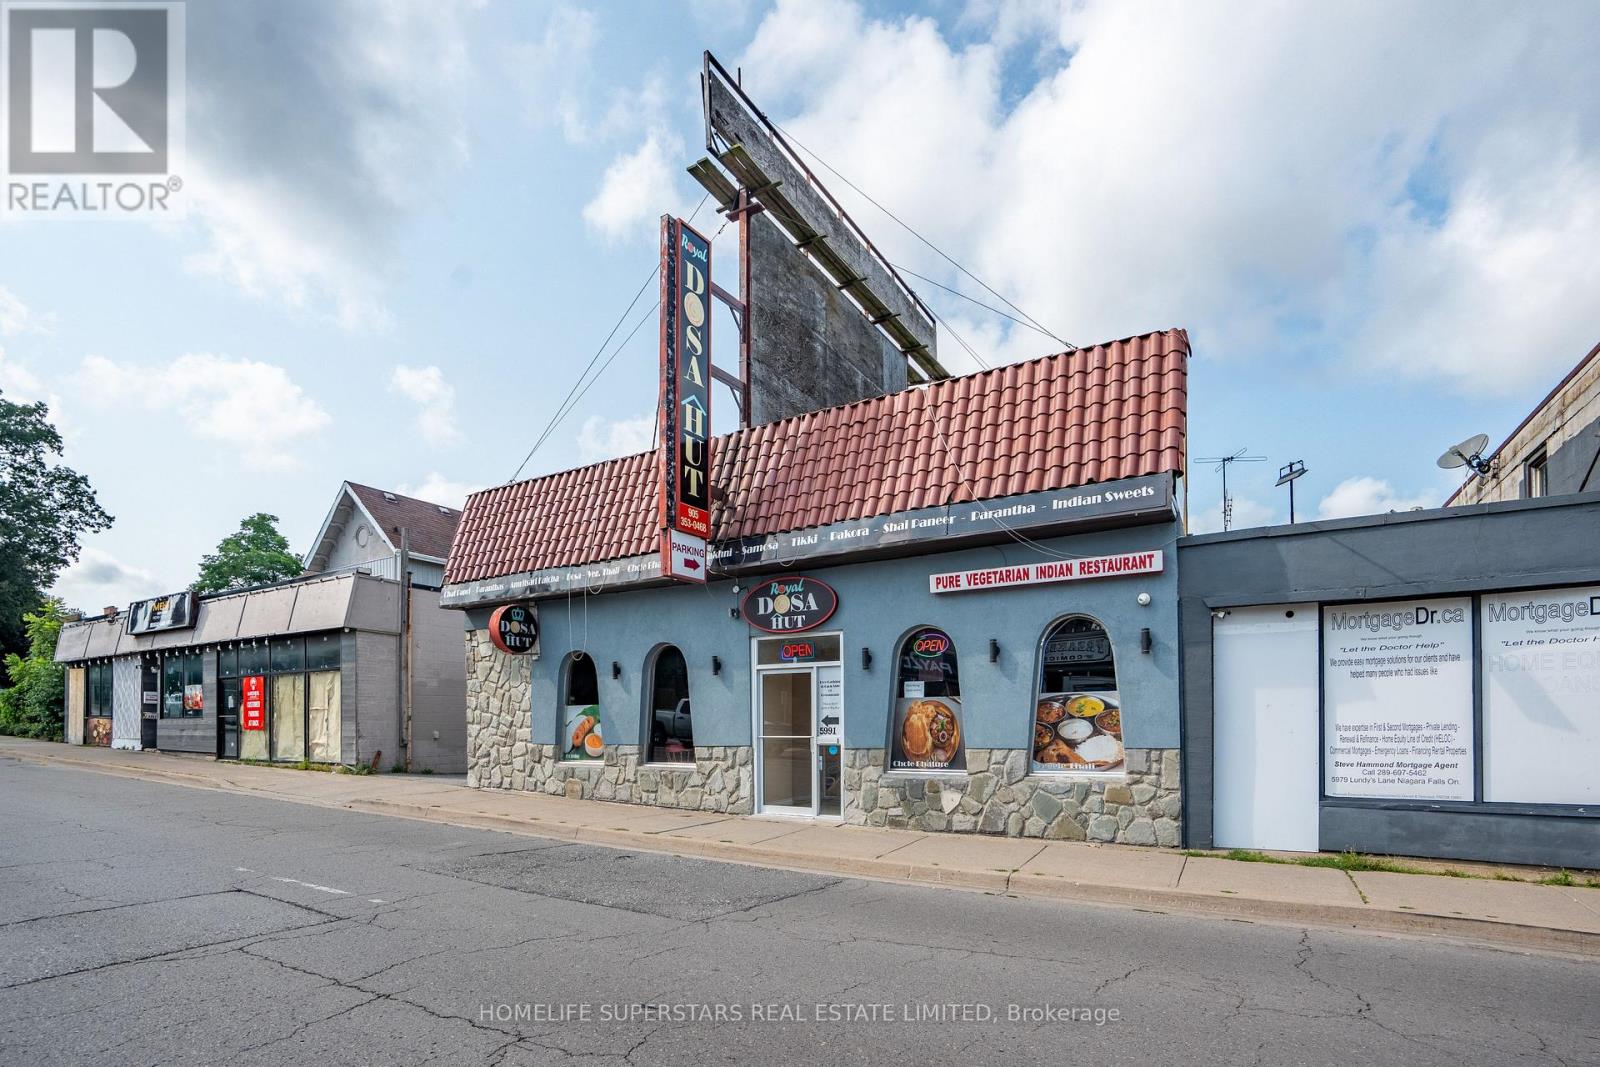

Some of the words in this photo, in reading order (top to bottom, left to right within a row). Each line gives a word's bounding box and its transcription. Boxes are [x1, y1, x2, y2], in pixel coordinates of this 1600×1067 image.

[681, 233, 708, 262] Royal
[684, 259, 705, 389] DOSA
[683, 402, 704, 498] HUT
[687, 508, 699, 519] 905
[741, 542, 779, 555] Samosa
[791, 533, 818, 547] Tikki
[830, 526, 870, 541] Pakora
[911, 515, 957, 529] Paneer
[971, 502, 1036, 522] Parantha
[1052, 493, 1102, 510] Indian
[1104, 485, 1155, 502] Sweets
[672, 542, 705, 559] PARKING
[935, 575, 961, 590] PURE
[966, 567, 1030, 588] VEGETARIAN
[1035, 562, 1073, 581] INDIAN
[1079, 554, 1155, 575] RESTAURANT
[770, 578, 804, 596] Royal
[758, 592, 819, 615] DOSA
[771, 615, 806, 629] HUT
[1331, 606, 1465, 633] MortgageDr.ca
[500, 620, 537, 635] DOSA
[504, 634, 532, 648] HUT
[914, 639, 946, 652] OPEN
[1415, 642, 1445, 650] Help"
[1549, 636, 1587, 644] Doctor
[783, 643, 813, 657] OPEN
[1338, 657, 1354, 668] provide
[1366, 656, 1387, 668] mortgage
[1387, 655, 1407, 665] solutions
[1439, 653, 1448, 662] and
[1449, 652, 1461, 662] have
[1379, 668, 1393, 679] people
[819, 727, 836, 735] 5991
[1334, 760, 1354, 768] Steve
[1356, 760, 1394, 768] Hammond
[1396, 761, 1433, 770] Mortgage
[1434, 761, 1458, 770] Agent
[1350, 777, 1376, 785] Lundy's
[1398, 777, 1426, 786] Niagara
[1428, 777, 1446, 785] Falls
